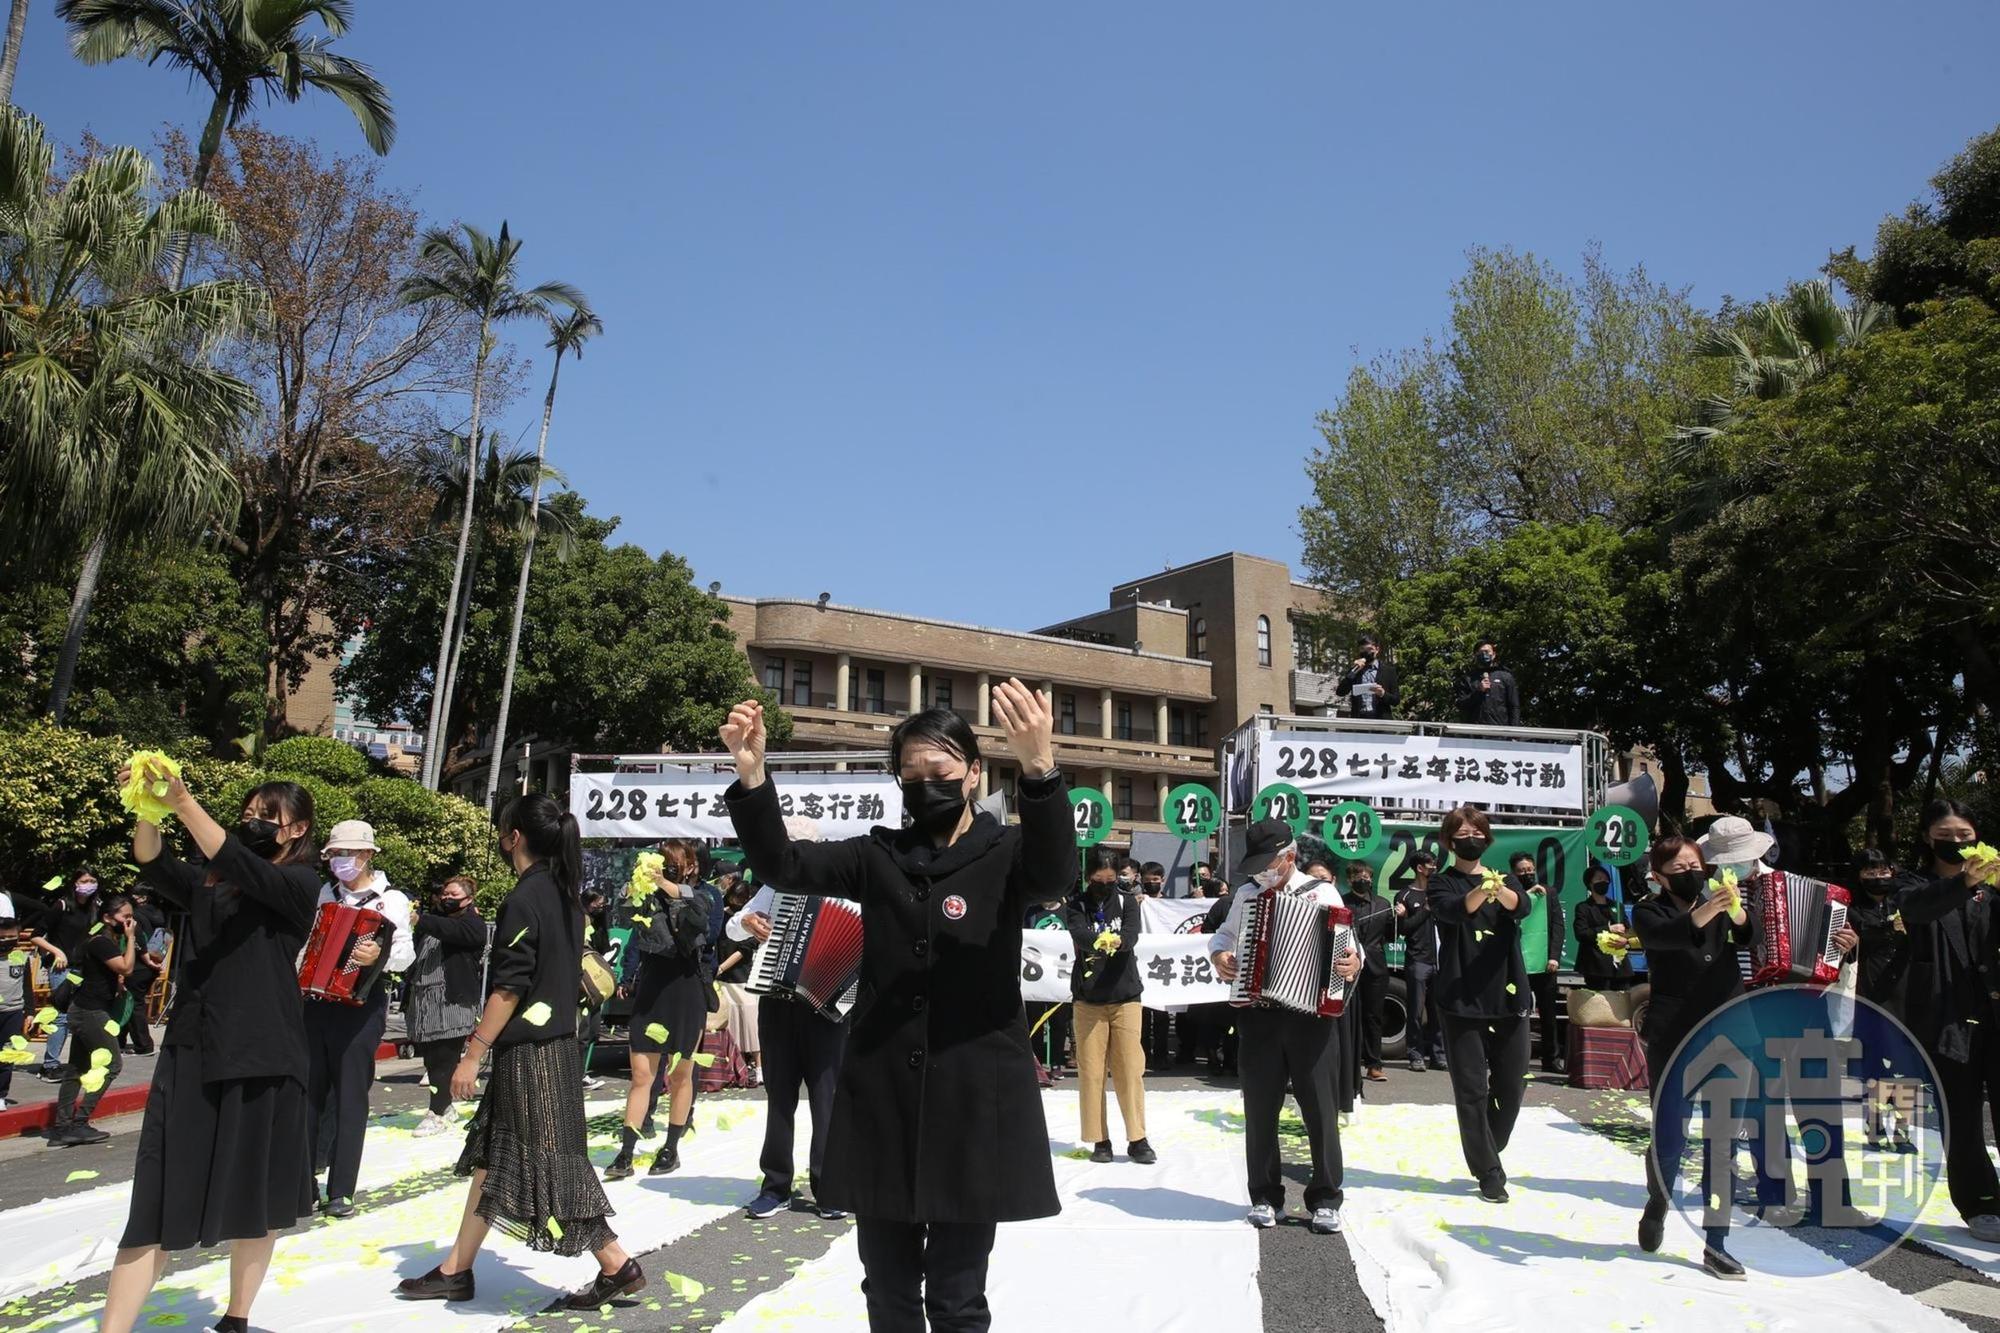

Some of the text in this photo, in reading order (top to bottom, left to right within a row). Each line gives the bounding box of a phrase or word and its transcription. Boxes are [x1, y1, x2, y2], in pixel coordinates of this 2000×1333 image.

[1077, 801, 1103, 829] 28
[1174, 796, 1213, 824] 228
[1261, 793, 1300, 820] 228
[1332, 811, 1372, 840] 228
[1594, 820, 1637, 848] 228
[792, 913, 813, 965] PIERMARIA
